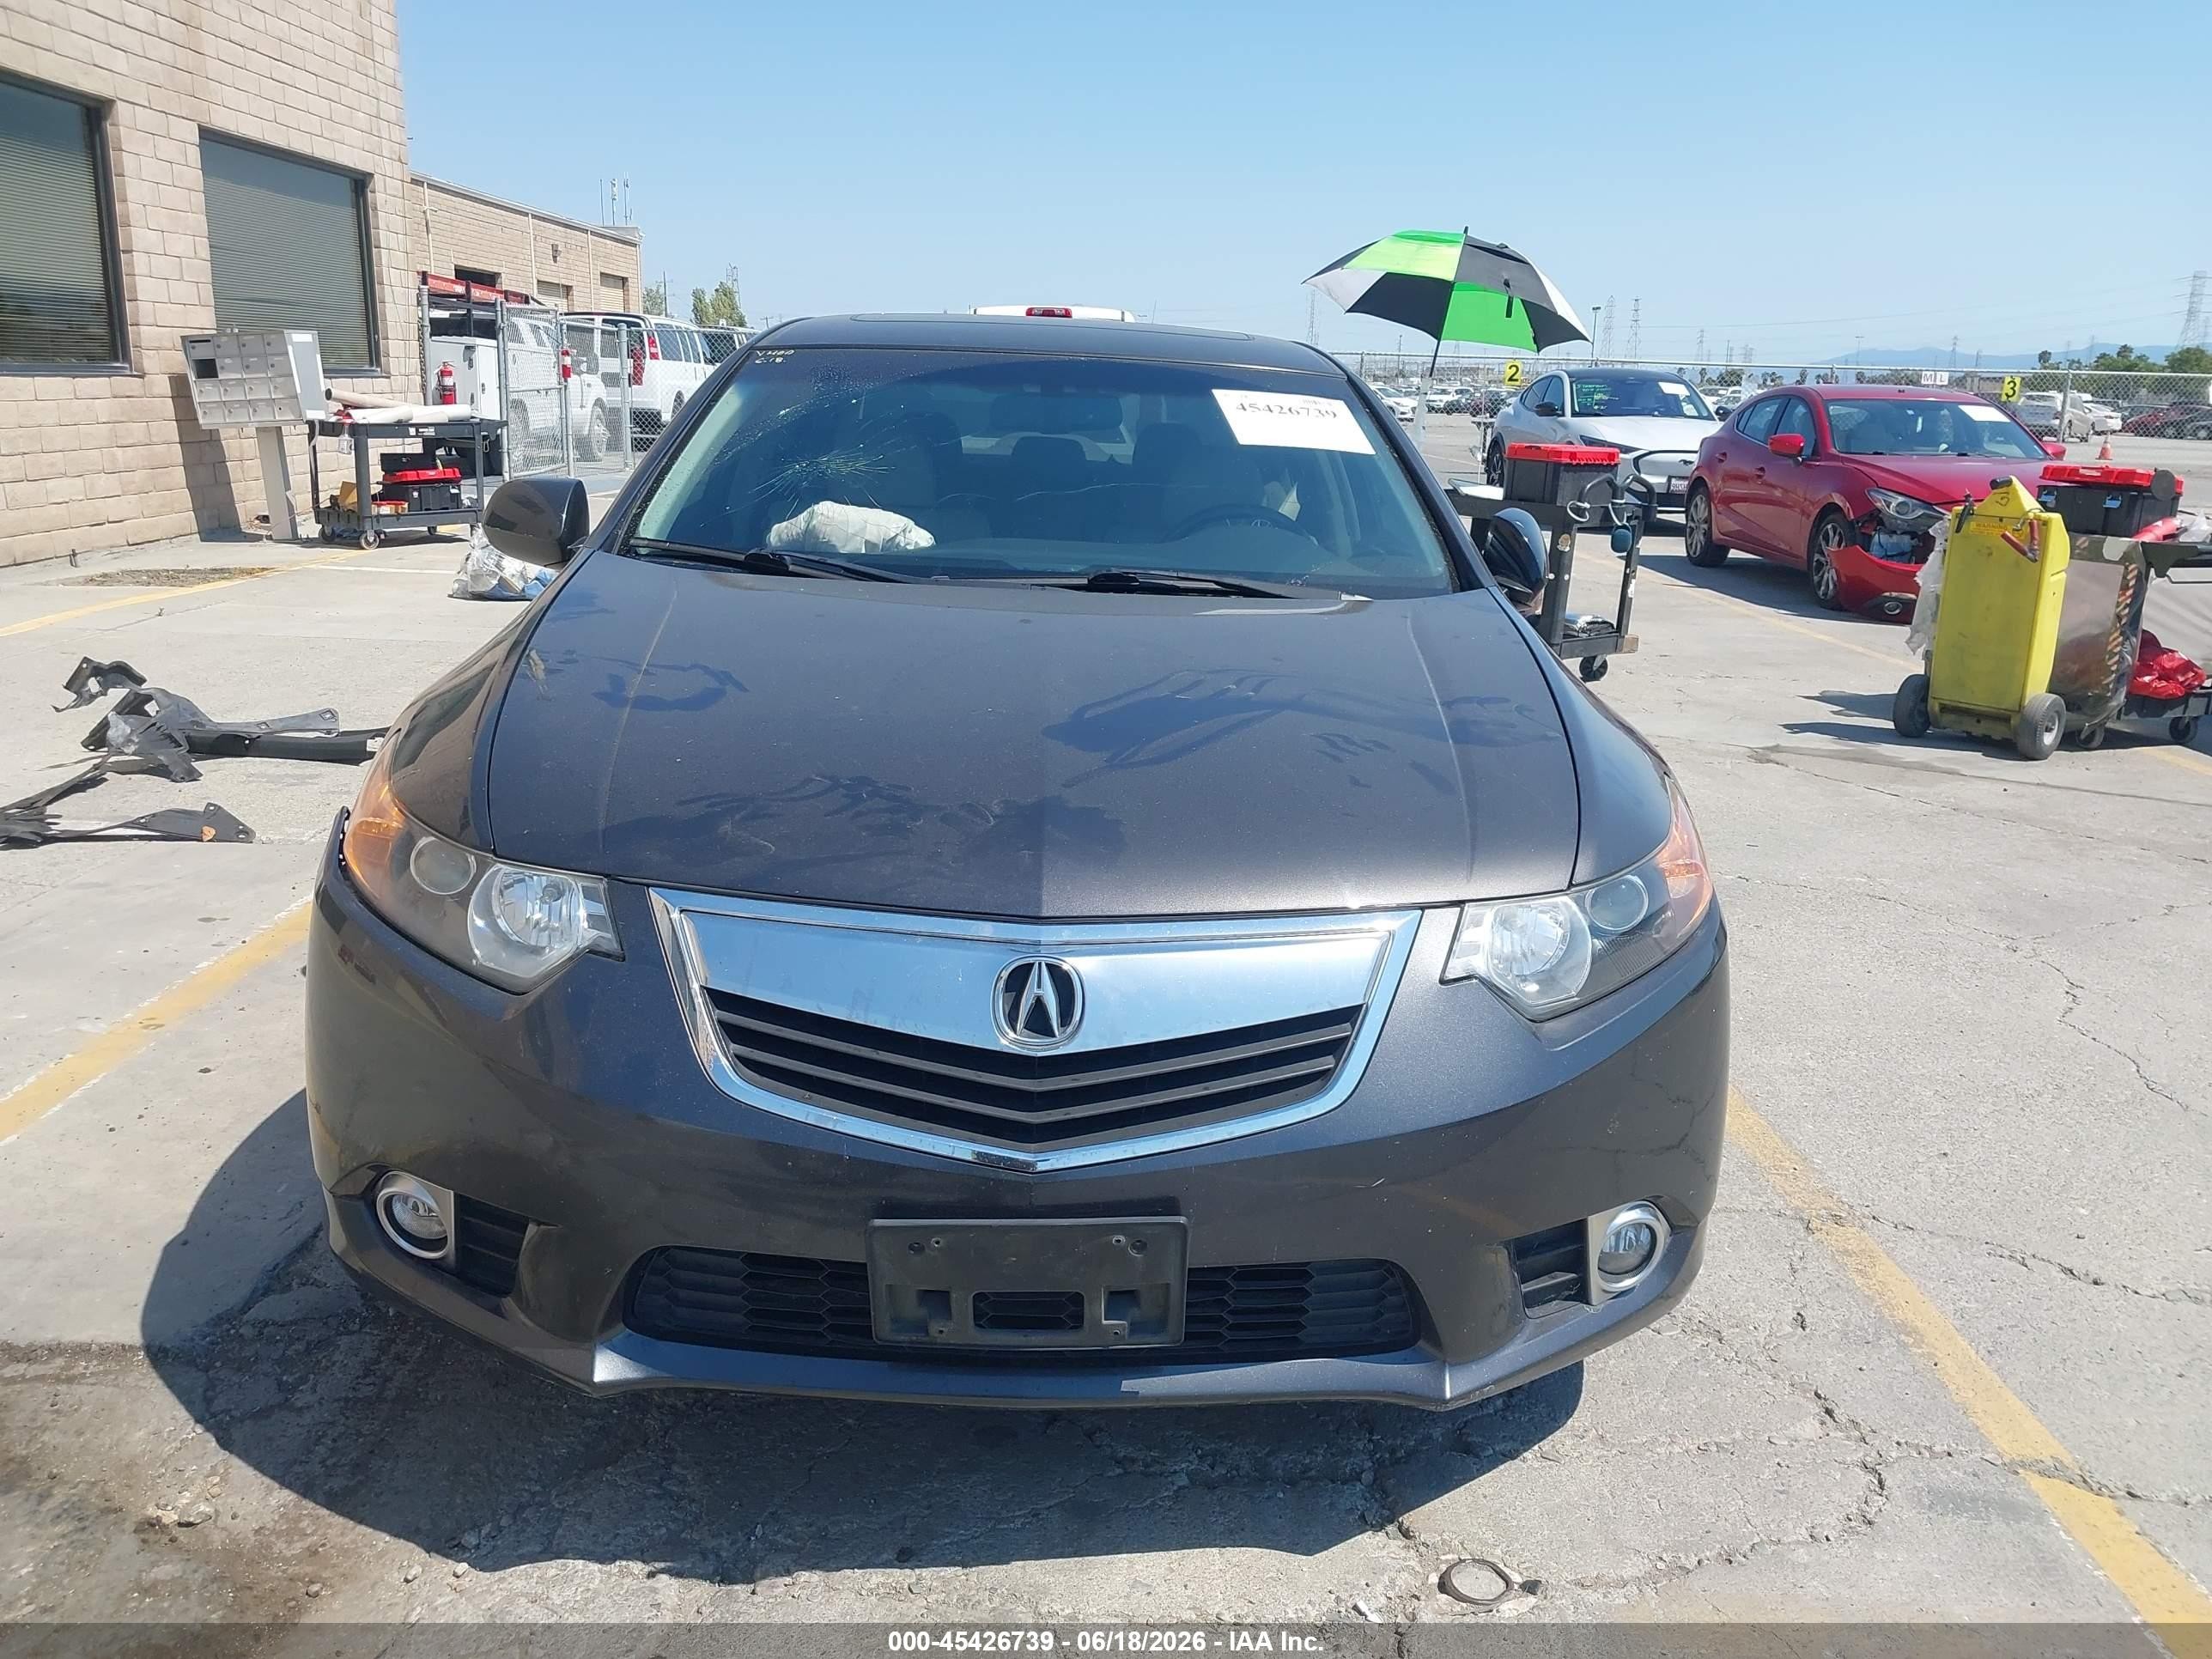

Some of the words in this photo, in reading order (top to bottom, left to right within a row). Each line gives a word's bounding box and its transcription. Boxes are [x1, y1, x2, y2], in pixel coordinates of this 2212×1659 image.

[1506, 363, 1520, 382] 2
[1923, 373, 1933, 383] M
[1939, 373, 1946, 383] L
[2004, 380, 2017, 398] 3
[1236, 402, 1338, 418] 45426739
